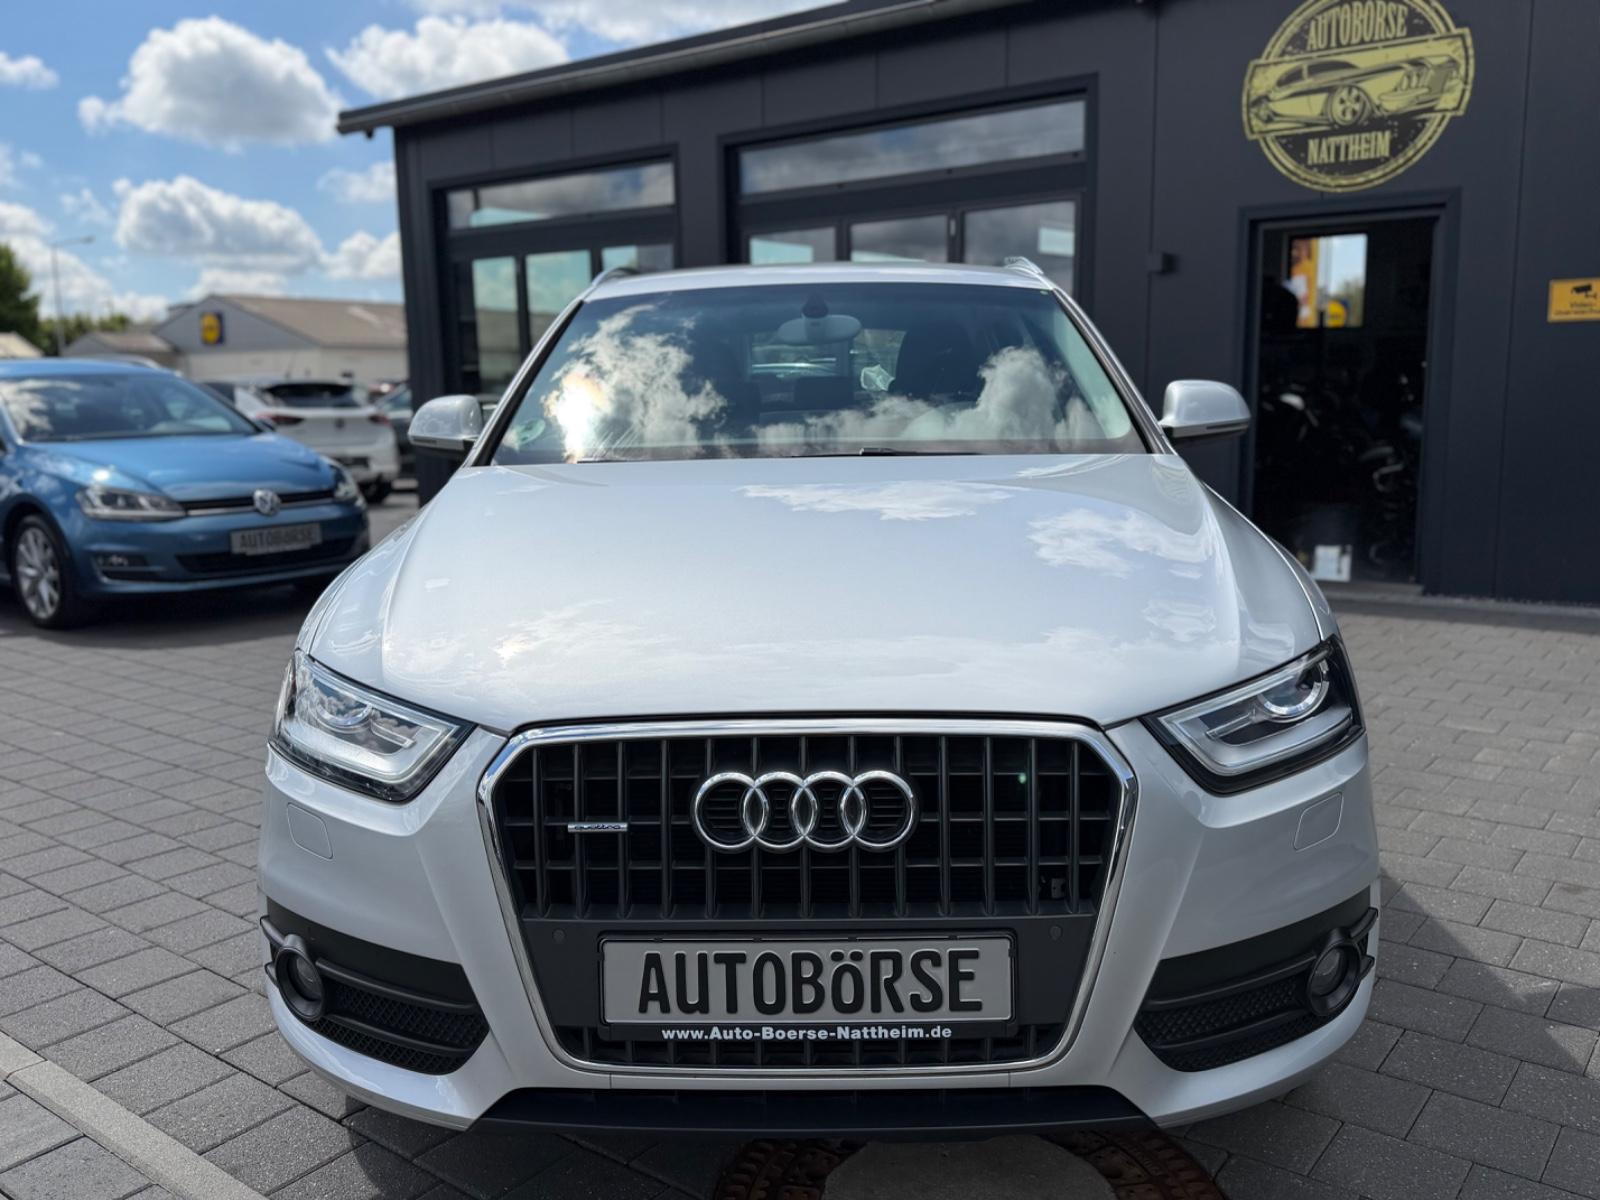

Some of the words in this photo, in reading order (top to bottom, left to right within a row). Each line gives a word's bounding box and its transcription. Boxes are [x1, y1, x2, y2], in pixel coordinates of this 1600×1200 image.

[1307, 131, 1391, 165] NATTHEIM
[638, 948, 982, 1015] AUTOBÖRSE
[662, 1026, 952, 1040] www.Auto-Boerse-Nattheim.de
